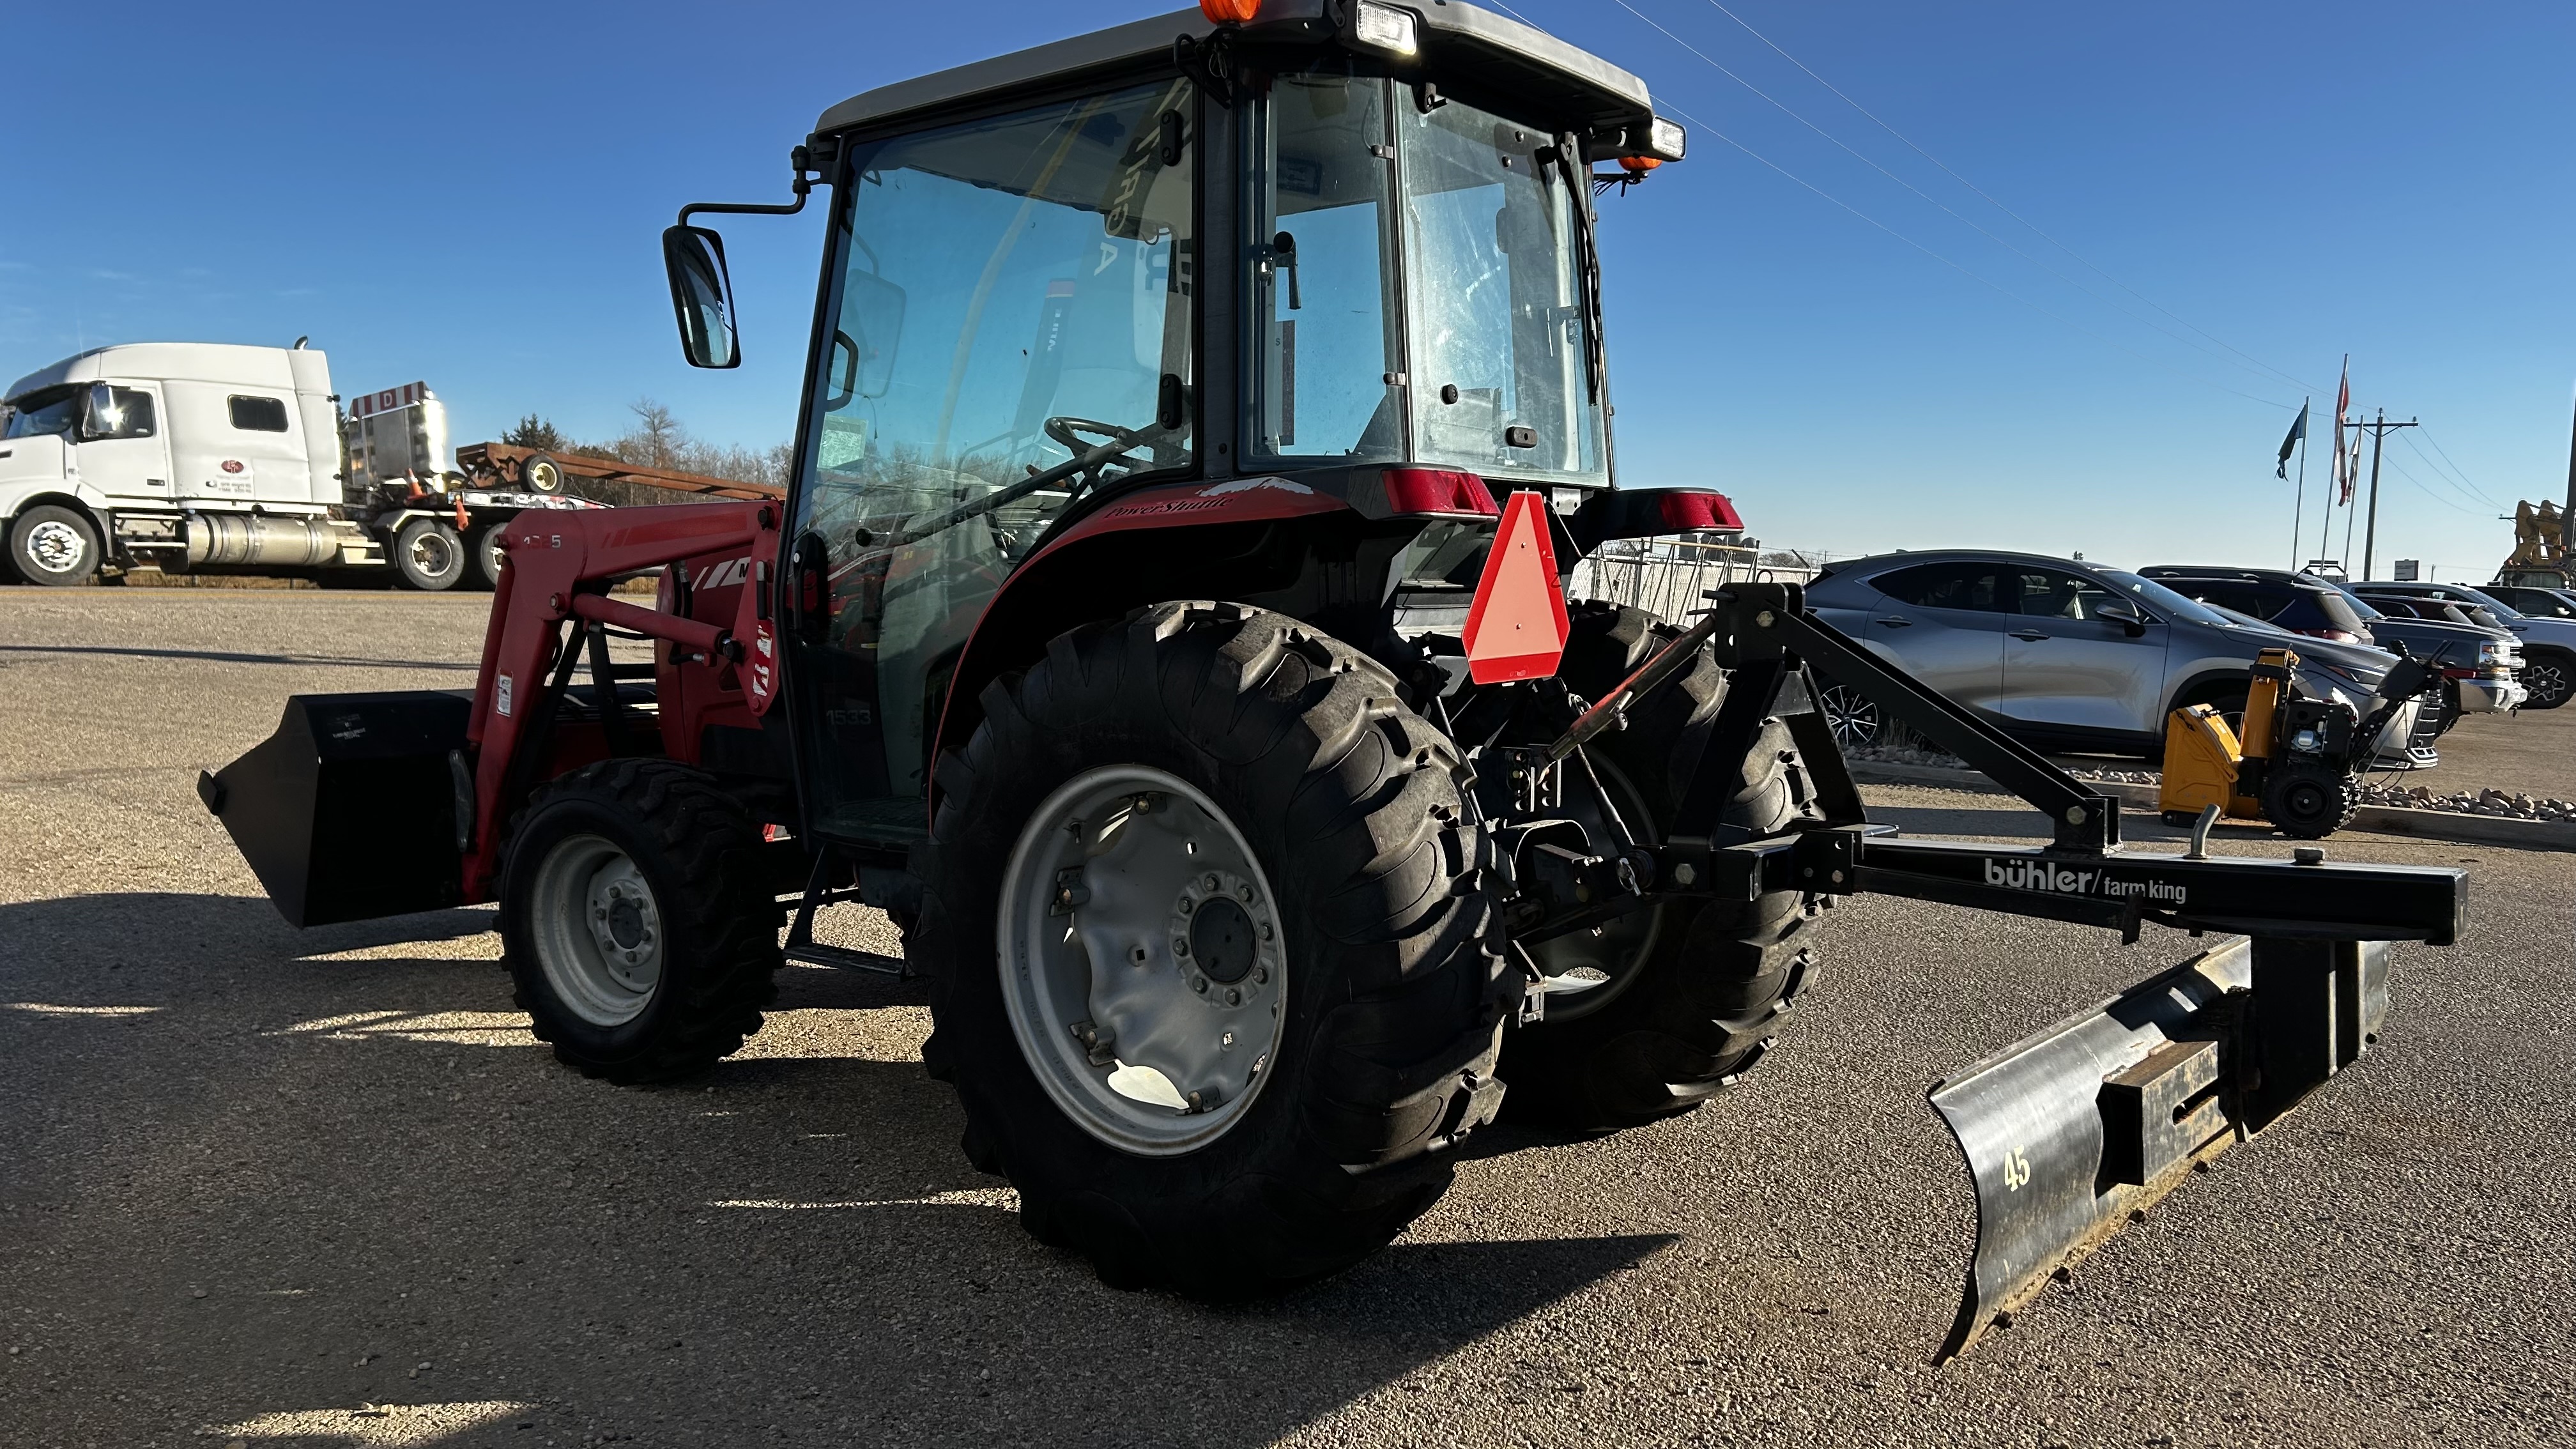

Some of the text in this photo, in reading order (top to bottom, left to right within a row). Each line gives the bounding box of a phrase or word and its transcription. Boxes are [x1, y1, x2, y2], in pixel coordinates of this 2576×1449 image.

[384, 392, 393, 407] D
[825, 710, 871, 725] 1533
[2104, 877, 2145, 898] farm
[2149, 879, 2186, 905] king
[2004, 1144, 2030, 1192] 45
